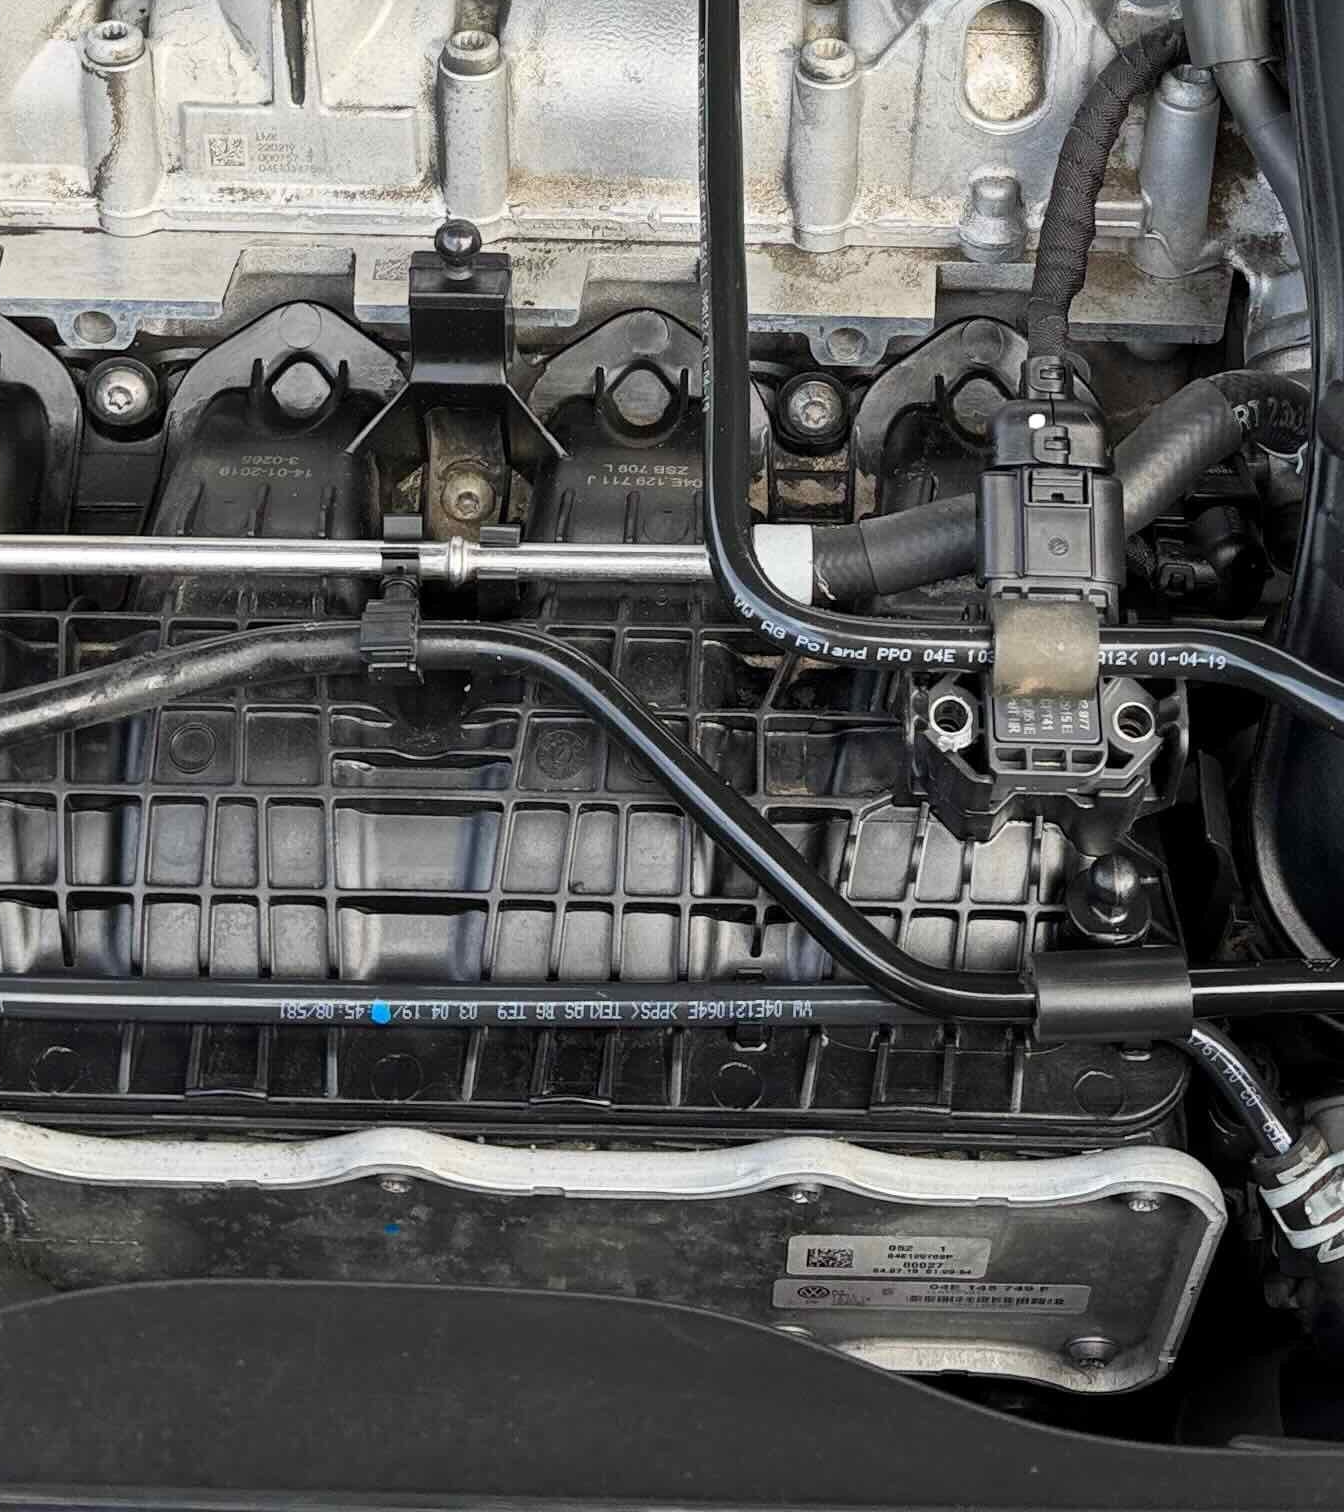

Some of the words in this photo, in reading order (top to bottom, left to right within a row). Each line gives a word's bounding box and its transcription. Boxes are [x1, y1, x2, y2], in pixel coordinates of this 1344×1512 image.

[760, 620, 786, 640] AG
[795, 634, 868, 661] Poland
[922, 648, 956, 663] 04E
[1148, 650, 1227, 670] 01-04-19
[496, 1002, 528, 1019] TE9
[565, 1002, 622, 1020] TEKLAS
